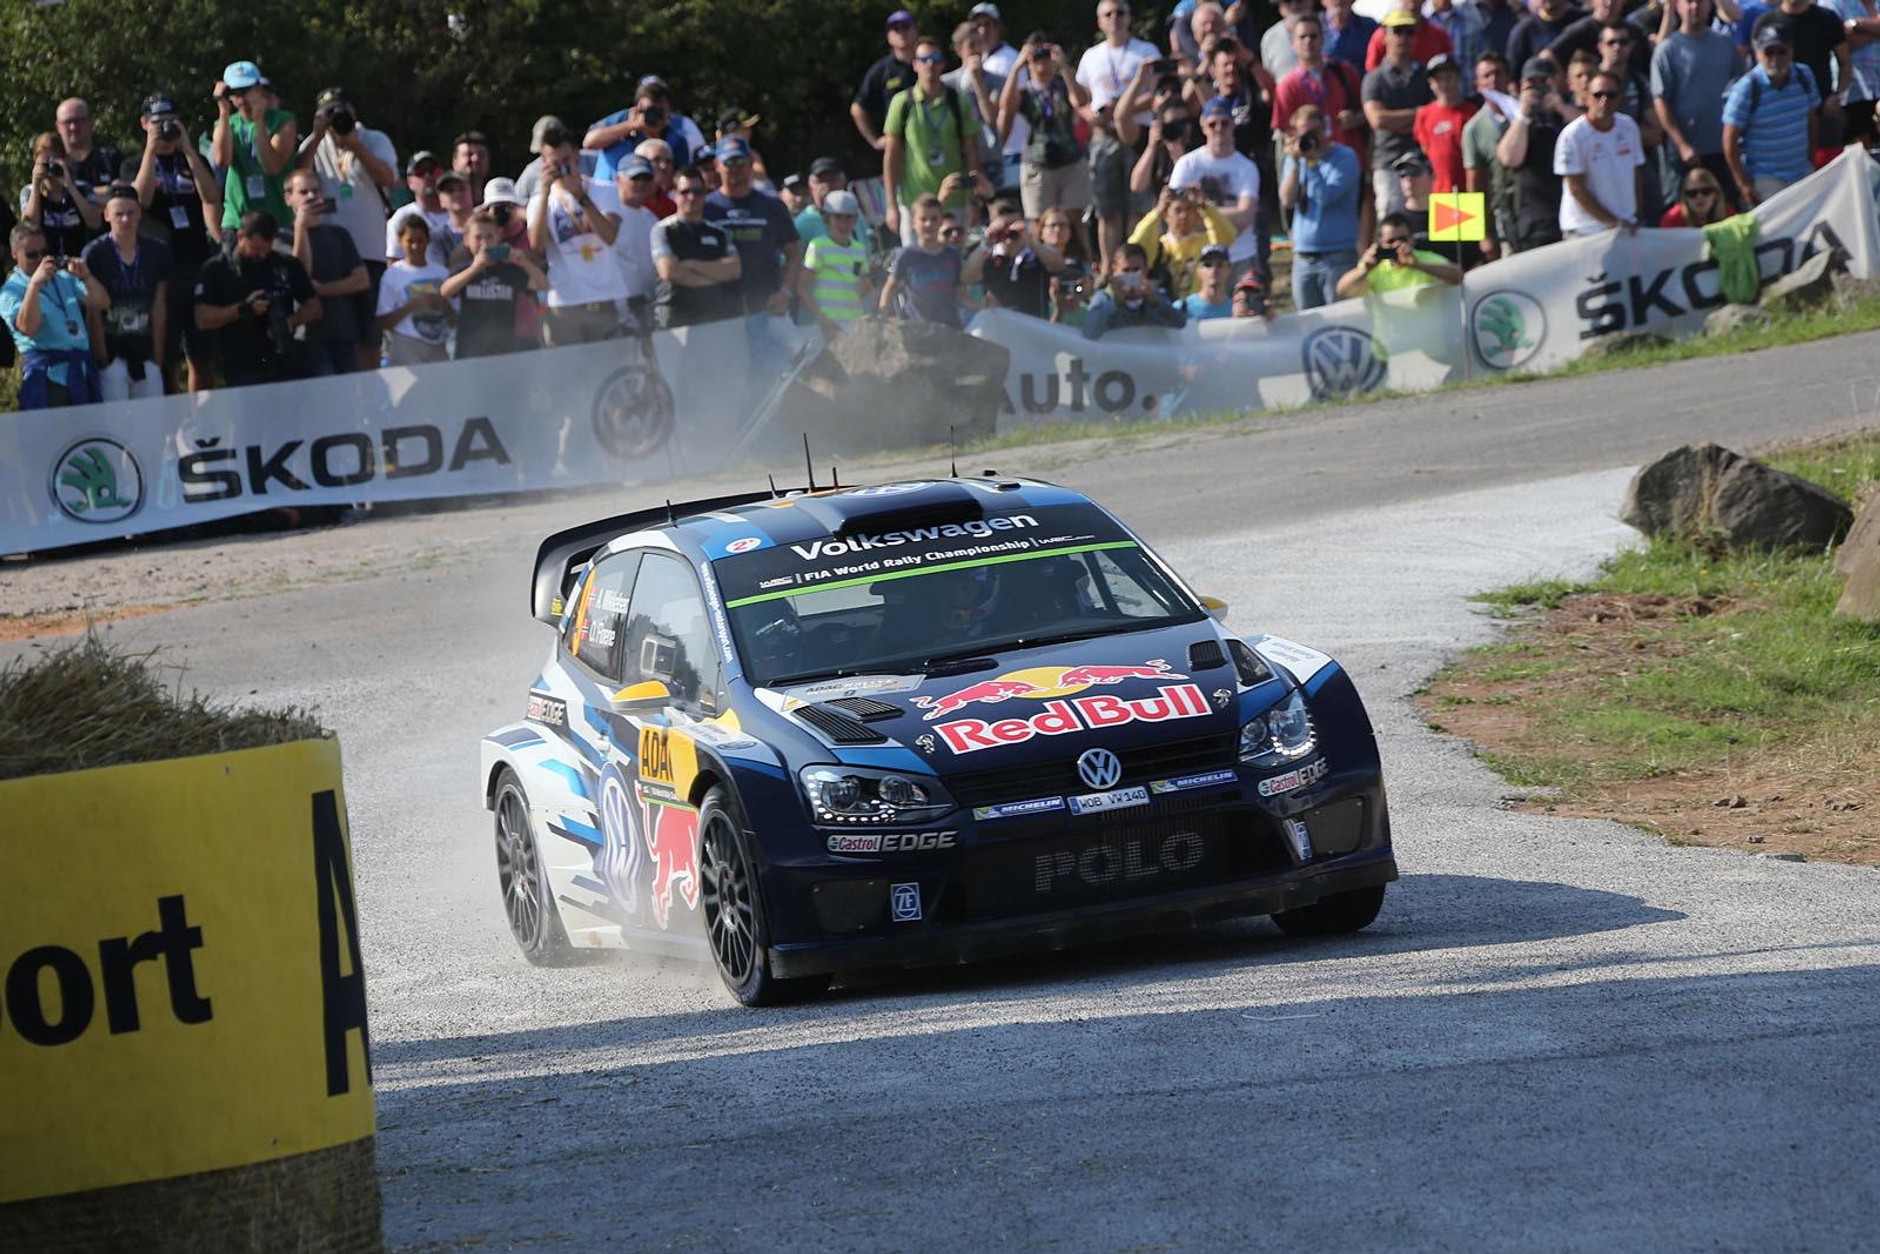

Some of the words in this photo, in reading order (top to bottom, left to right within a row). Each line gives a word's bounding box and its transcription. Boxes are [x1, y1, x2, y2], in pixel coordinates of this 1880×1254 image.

[996, 357, 1158, 415] uto.
[177, 416, 512, 504] ŠKODA
[790, 513, 1039, 561] Volkswagen
[804, 569, 832, 582] FIA
[833, 559, 880, 576] World
[883, 551, 922, 569] Rally
[925, 539, 1030, 562] Championship
[933, 699, 1082, 755] Red
[1071, 683, 1213, 729] Bull
[1177, 771, 1233, 787] MICHELIN
[1270, 771, 1298, 793] Castrol
[1001, 798, 1061, 814] MICHELIN
[1080, 796, 1101, 809] WOB
[838, 836, 879, 851] Castrol
[881, 831, 959, 852] EDGE
[1035, 832, 1205, 892] POLO
[0, 894, 213, 1046] ort
